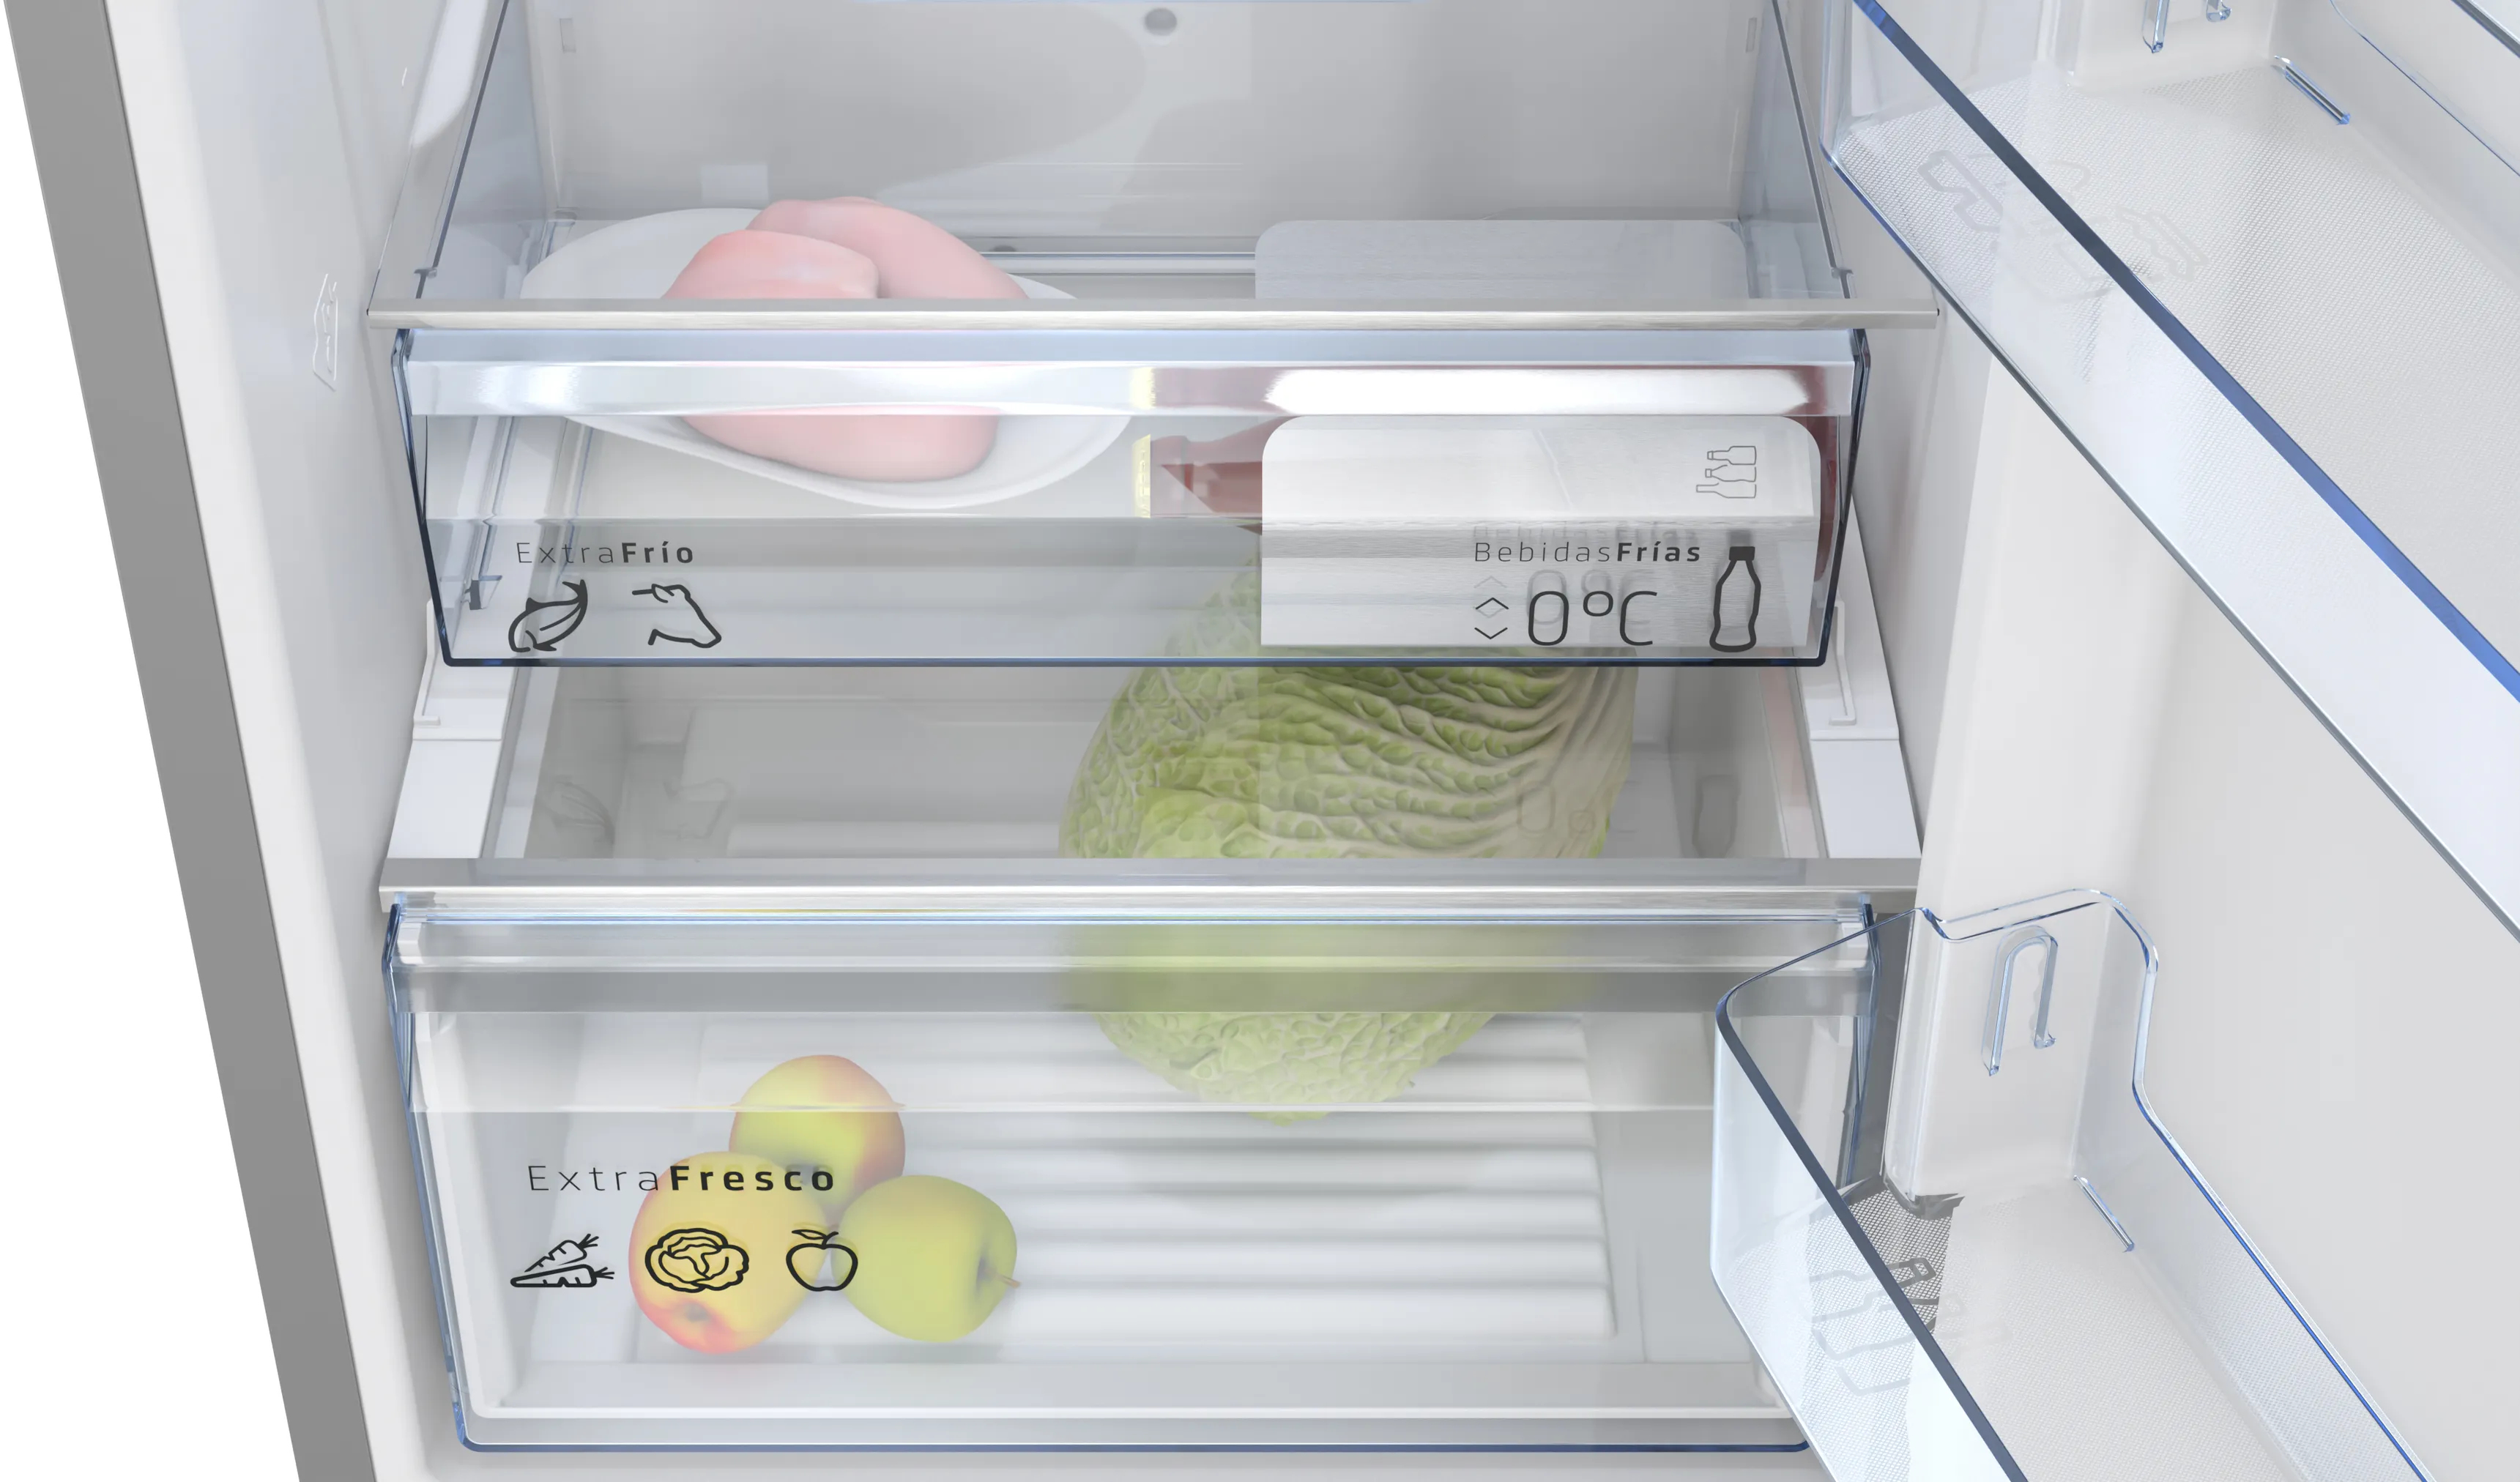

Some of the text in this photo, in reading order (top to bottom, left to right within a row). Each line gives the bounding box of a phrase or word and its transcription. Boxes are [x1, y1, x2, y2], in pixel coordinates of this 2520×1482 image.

[516, 540, 694, 564] ExtraFrío
[1473, 540, 1701, 562] BebidasFrías
[527, 1164, 834, 1192] ExtraFresco
